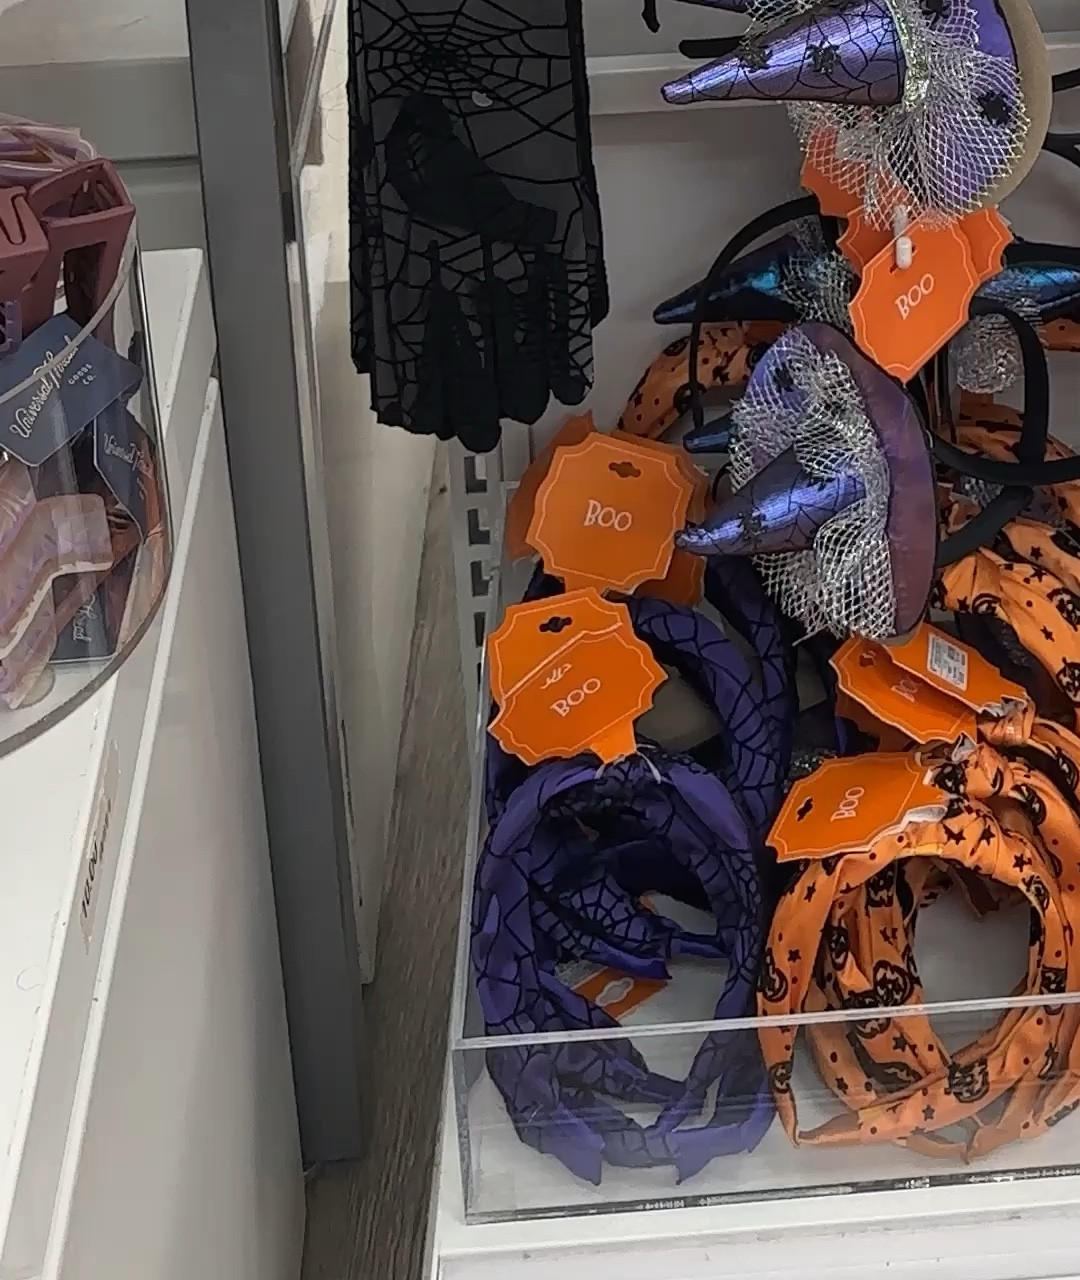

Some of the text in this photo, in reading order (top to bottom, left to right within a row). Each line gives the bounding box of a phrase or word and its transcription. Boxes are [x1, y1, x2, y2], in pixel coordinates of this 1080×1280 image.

[896, 273, 935, 320] BOO
[9, 377, 55, 439] Universal
[584, 500, 632, 532] BOO
[549, 677, 601, 717] BOO
[830, 786, 865, 823] BOO
